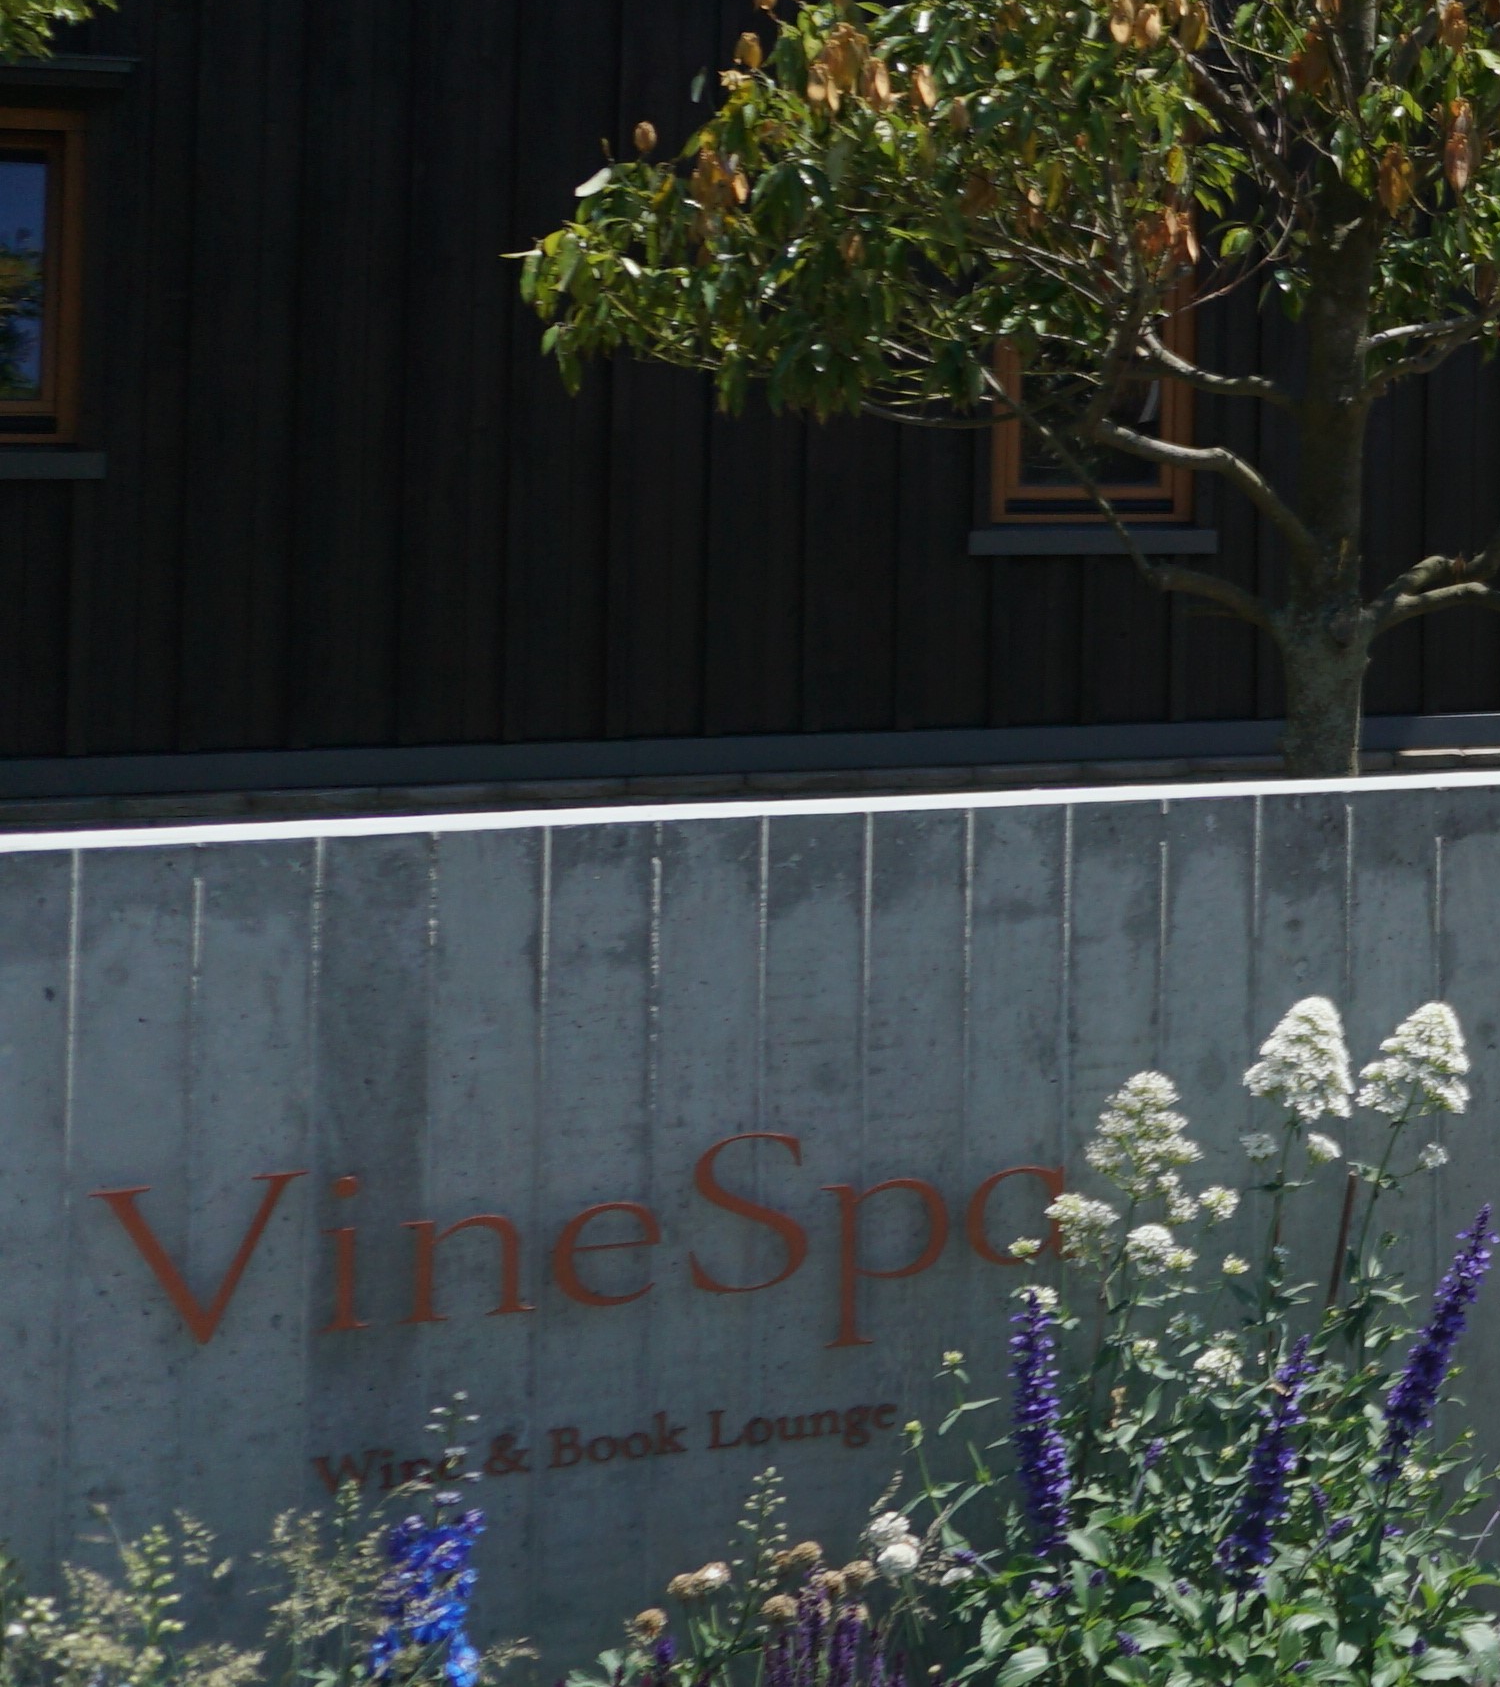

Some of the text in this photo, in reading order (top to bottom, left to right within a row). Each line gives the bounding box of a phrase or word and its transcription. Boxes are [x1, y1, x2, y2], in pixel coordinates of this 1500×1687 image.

[90, 1132, 1076, 1347] VineSpa
[483, 1431, 531, 1476] &
[547, 1411, 688, 1469] Book
[707, 1402, 898, 1449] Lounge
